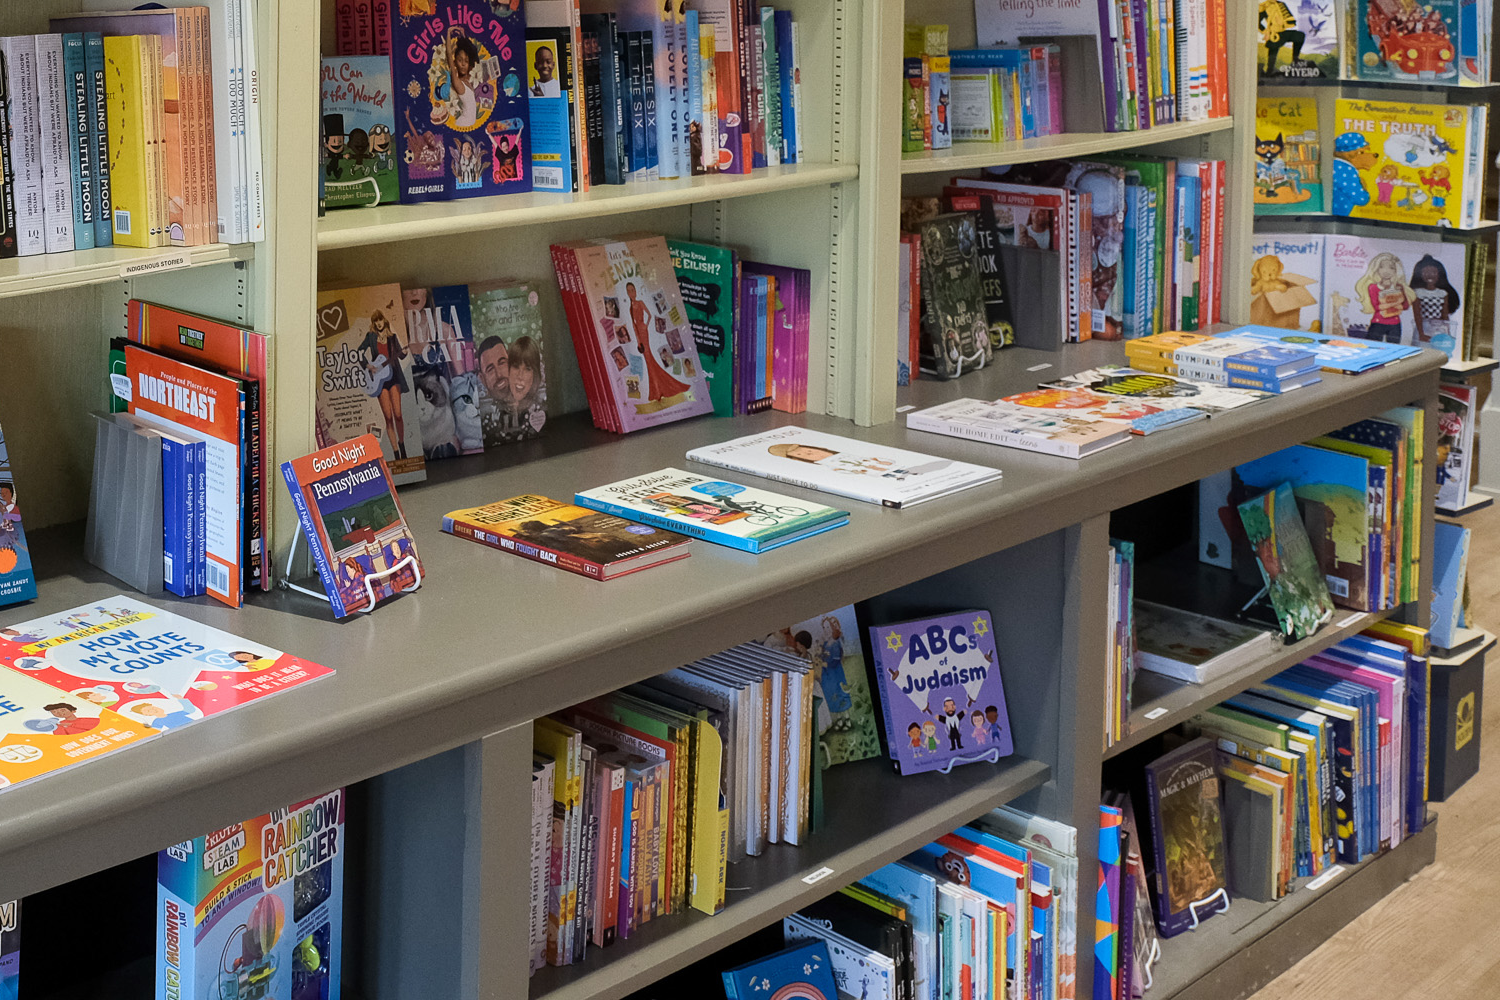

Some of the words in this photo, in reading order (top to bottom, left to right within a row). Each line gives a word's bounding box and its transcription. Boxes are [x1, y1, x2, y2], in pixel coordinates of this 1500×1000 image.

[407, 16, 443, 65] Girls
[446, 6, 483, 34] Like
[488, 19, 513, 62] Me
[1279, 101, 1303, 118] Cat
[1343, 118, 1374, 131] THE
[1380, 121, 1436, 136] TRUTH
[1274, 241, 1318, 255] Biscuit!
[1334, 243, 1368, 258] Barbie
[126, 262, 160, 273] INDIGENOUS
[161, 258, 183, 267] STORIES
[316, 347, 366, 369] Taylor
[1174, 351, 1222, 368] OLYMPIANS
[322, 367, 366, 392] Swift
[1179, 366, 1226, 385] OLYMPIANS
[139, 372, 216, 423] NORTHEAST
[312, 449, 338, 473] Good
[338, 443, 366, 466] Night
[313, 465, 382, 499] Pennsylvania
[78, 628, 139, 654] HOW
[78, 650, 122, 673] MY
[120, 631, 188, 660] VOTE
[907, 624, 979, 664] ABCs
[109, 639, 206, 675] COUNTS
[939, 656, 949, 668] of
[900, 666, 988, 696] Judaism
[262, 790, 341, 858] RAINBOW
[263, 828, 338, 890] CATCHER
